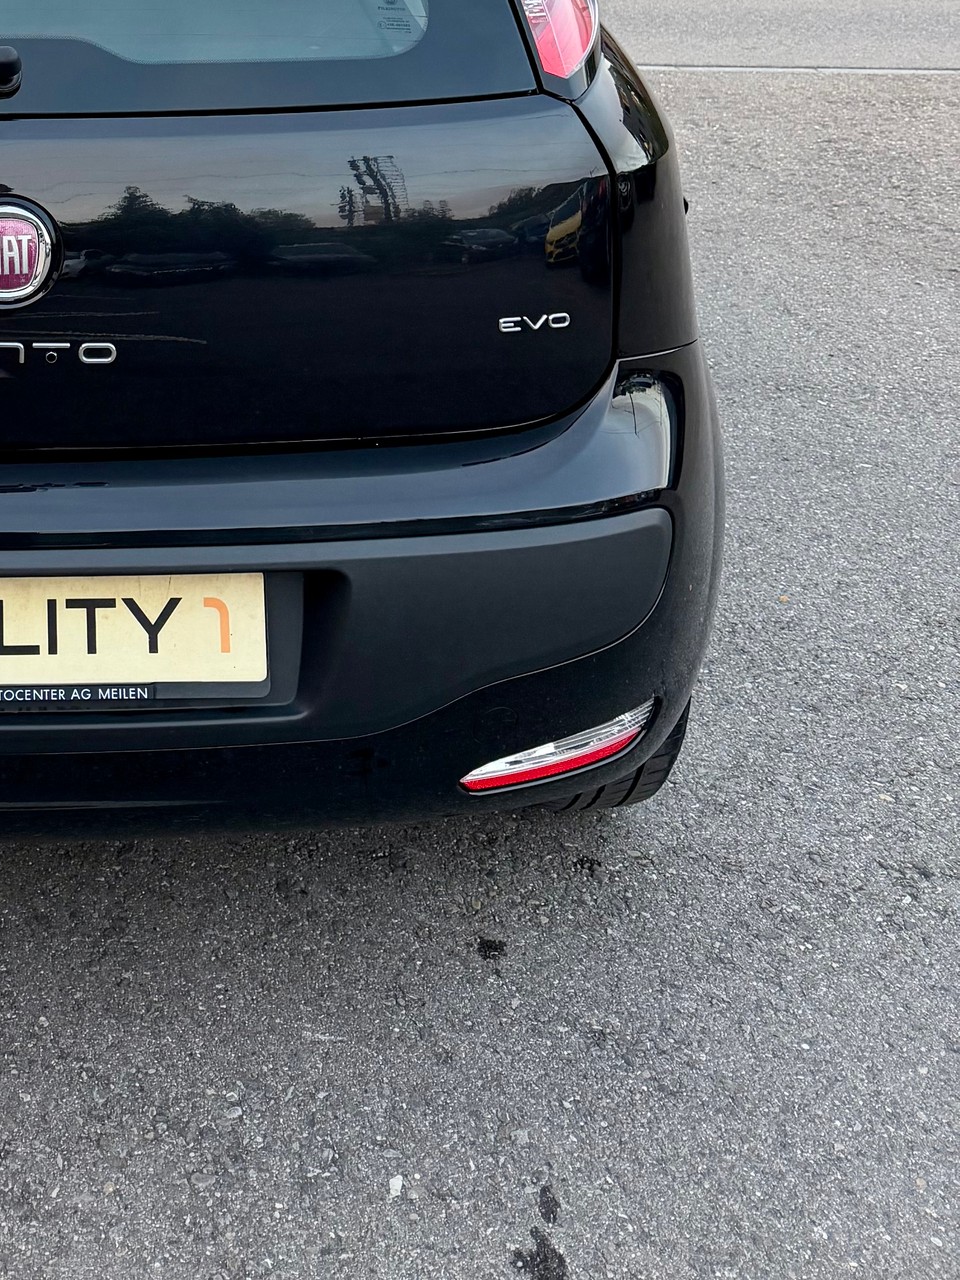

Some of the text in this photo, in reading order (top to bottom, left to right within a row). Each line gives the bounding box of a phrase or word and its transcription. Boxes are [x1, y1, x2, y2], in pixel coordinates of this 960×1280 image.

[499, 312, 571, 332] EVO
[203, 596, 231, 654] 1
[70, 688, 92, 701] AG
[98, 687, 148, 700] MEILEN
